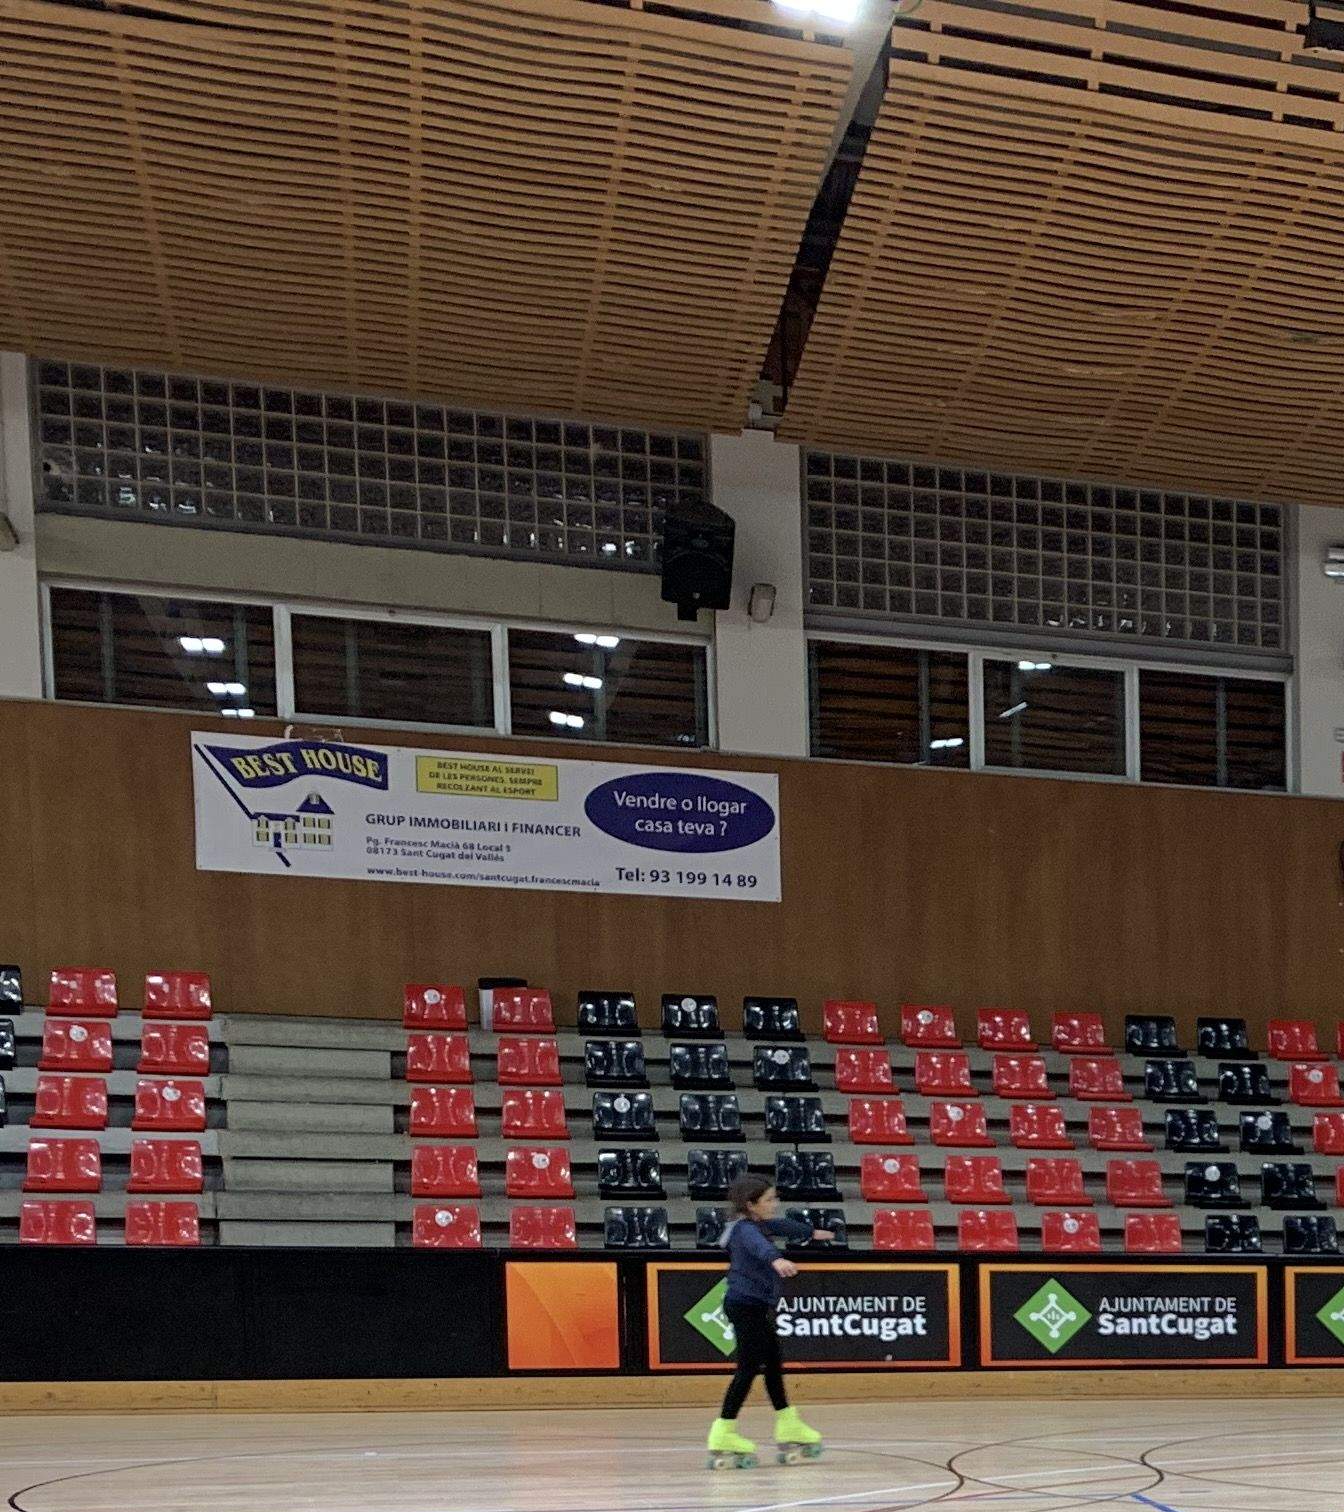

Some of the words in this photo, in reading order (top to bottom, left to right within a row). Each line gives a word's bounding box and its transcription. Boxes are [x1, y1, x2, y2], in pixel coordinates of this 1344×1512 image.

[230, 752, 298, 779] BEST
[300, 749, 383, 782] HOUSE
[437, 761, 458, 770] BEST
[460, 763, 490, 772] HOUSE
[613, 791, 677, 810] Vendre
[681, 798, 693, 811] o
[697, 796, 747, 817] llogar
[365, 813, 406, 826] GRUP
[409, 816, 501, 832] IMMOBILIARI
[512, 822, 582, 837] FINANCER
[635, 819, 673, 833] casa
[677, 820, 715, 836] teva
[719, 821, 728, 836] ?
[366, 847, 398, 857] 08173
[400, 848, 422, 858] Sant
[425, 850, 455, 861] Cugat
[458, 852, 474, 861] del
[384, 837, 428, 848] Francesc
[477, 842, 503, 852] Local
[615, 867, 645, 882] Tel:
[649, 870, 670, 883] 93
[676, 871, 707, 885] 199
[714, 873, 732, 887] 14
[737, 874, 758, 888] 89
[776, 1296, 898, 1313] AJUNTAMENT
[902, 1296, 927, 1312] DE
[1099, 1297, 1211, 1313] AJUNTAMENT
[1215, 1297, 1237, 1312] DE
[775, 1313, 927, 1342] SantCugat
[1097, 1313, 1238, 1341] SantCugat
